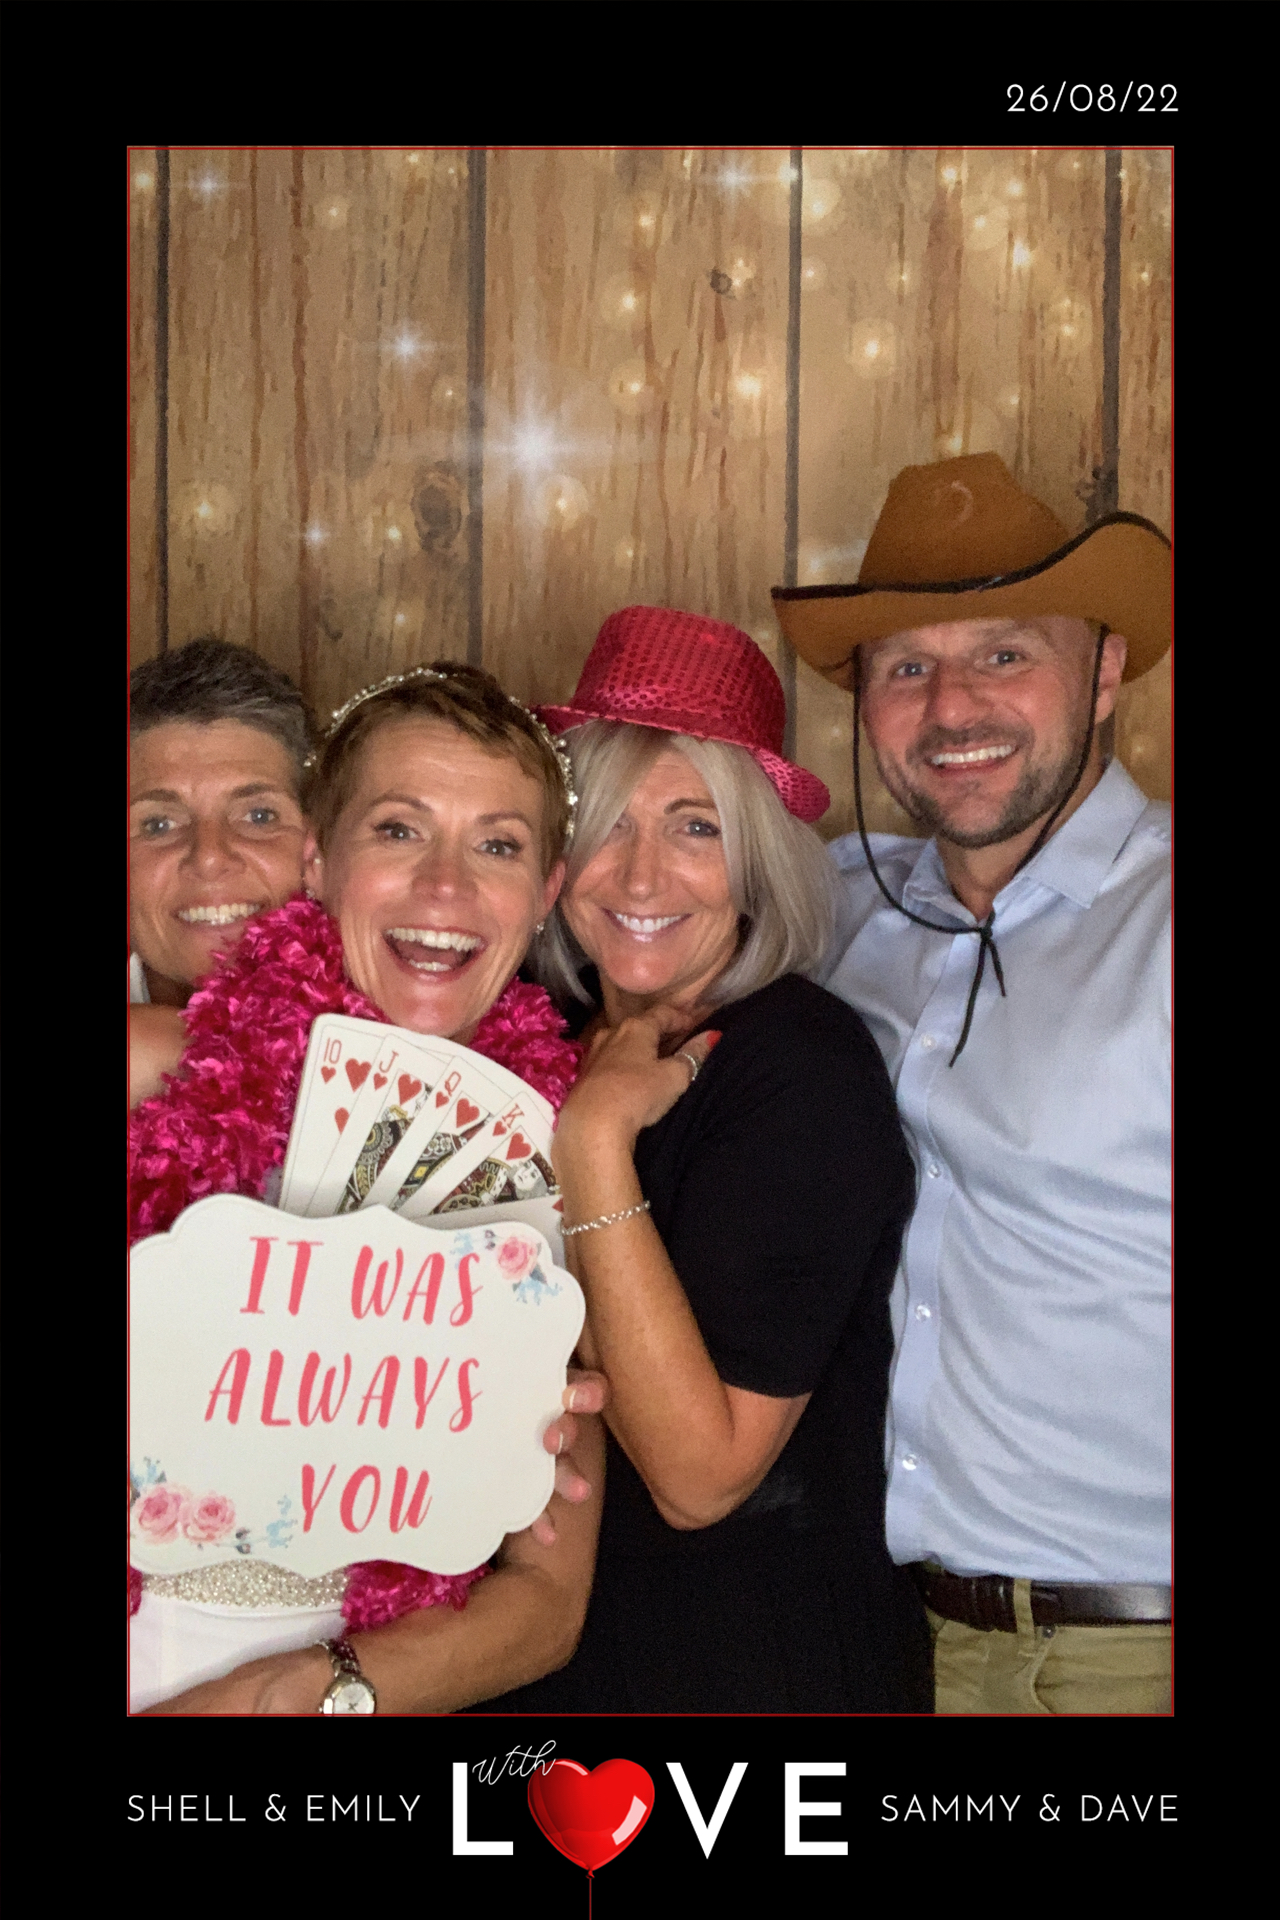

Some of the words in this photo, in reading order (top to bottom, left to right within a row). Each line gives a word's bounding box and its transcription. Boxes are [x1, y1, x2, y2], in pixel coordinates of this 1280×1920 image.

[323, 1036, 343, 1066] 10
[378, 1050, 400, 1074] J
[443, 1070, 462, 1097] Q
[501, 1103, 525, 1129] K
[239, 1236, 324, 1317] IT
[350, 1244, 484, 1328] WAS
[204, 1347, 484, 1434] ALWAYS
[301, 1463, 433, 1535] YOU
